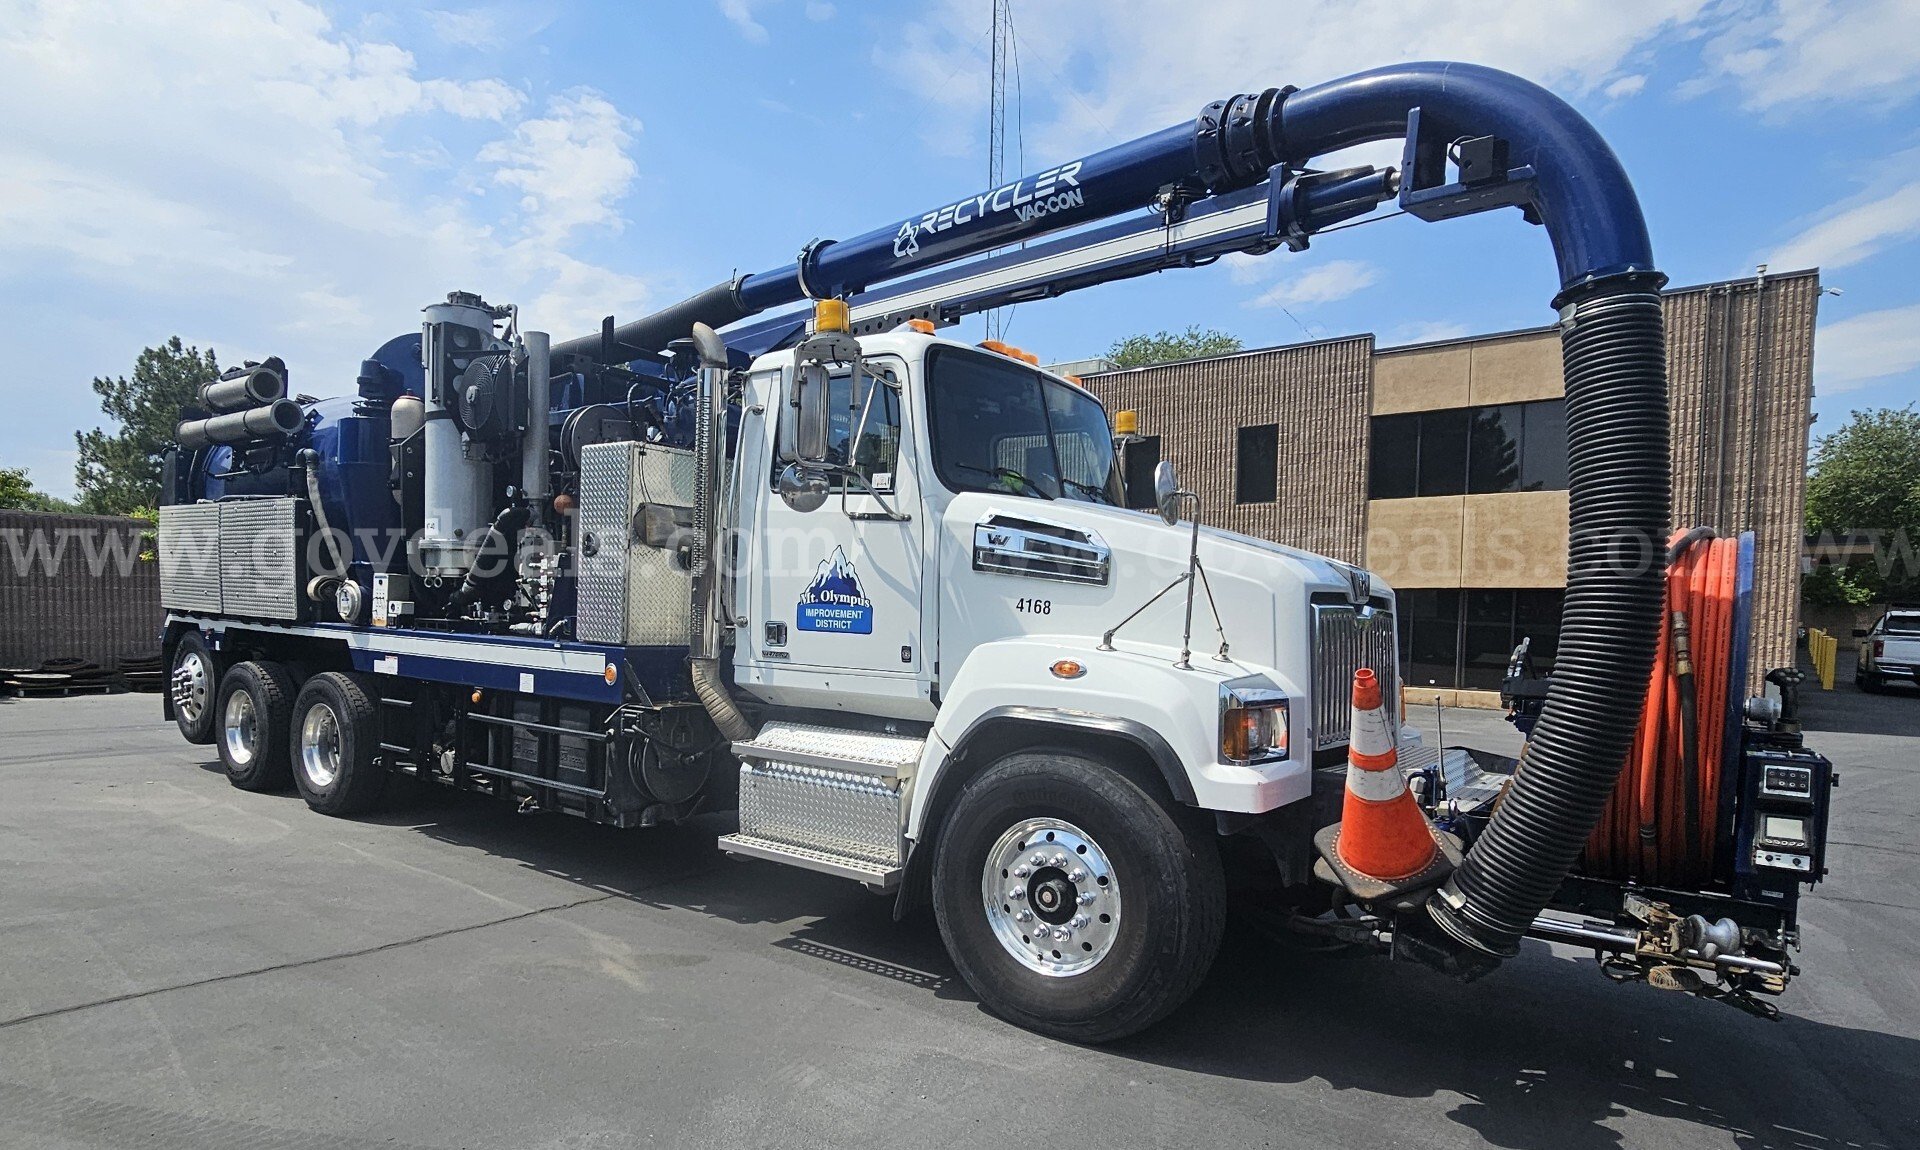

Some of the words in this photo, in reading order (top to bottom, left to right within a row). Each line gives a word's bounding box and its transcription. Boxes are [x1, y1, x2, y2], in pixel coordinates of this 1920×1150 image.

[919, 161, 1083, 235] RECYCLER
[799, 591, 819, 606] Mt.
[820, 589, 871, 608] Olympus
[1015, 597, 1052, 615] 4168
[805, 608, 864, 619] IMPROVEMENT
[815, 620, 852, 630] DISTRICT
